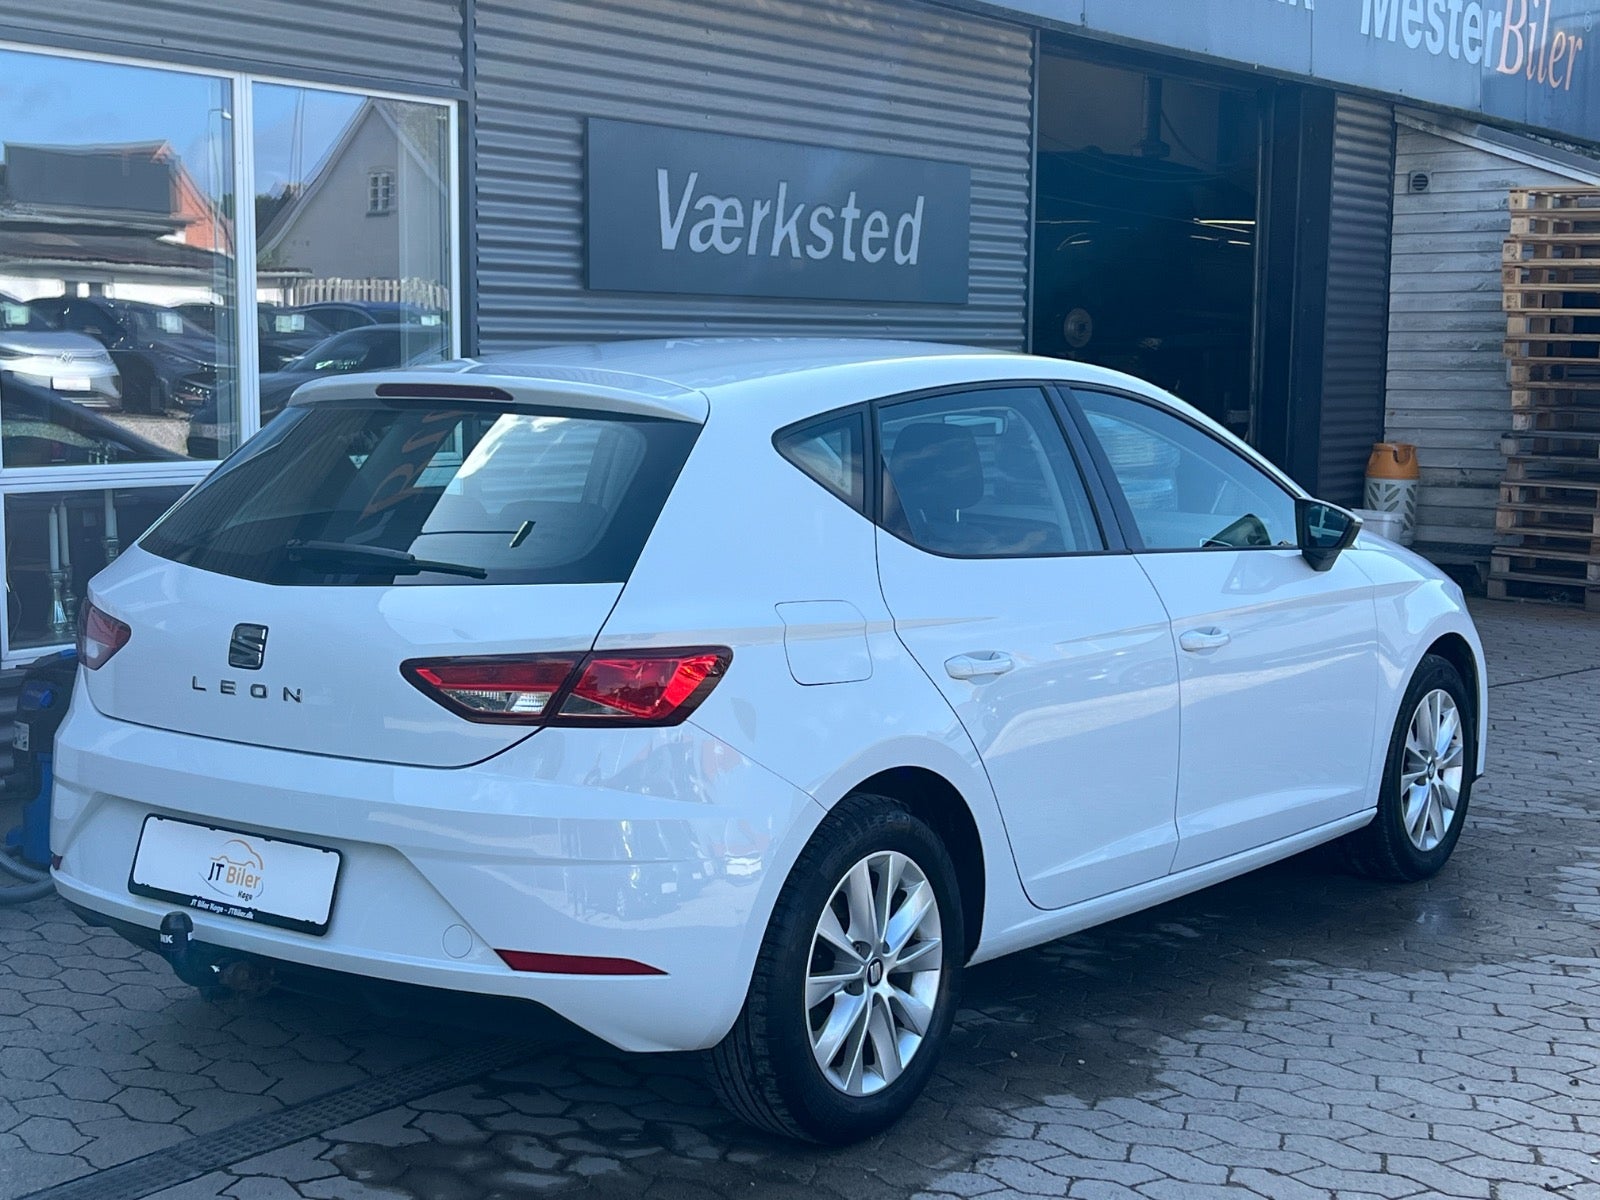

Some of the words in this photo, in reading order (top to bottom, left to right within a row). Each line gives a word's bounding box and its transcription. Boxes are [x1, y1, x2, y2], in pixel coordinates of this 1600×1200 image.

[657, 168, 925, 265] Værksted
[192, 675, 302, 703] LEON
[207, 862, 225, 881] JT
[226, 866, 261, 889] Biler
